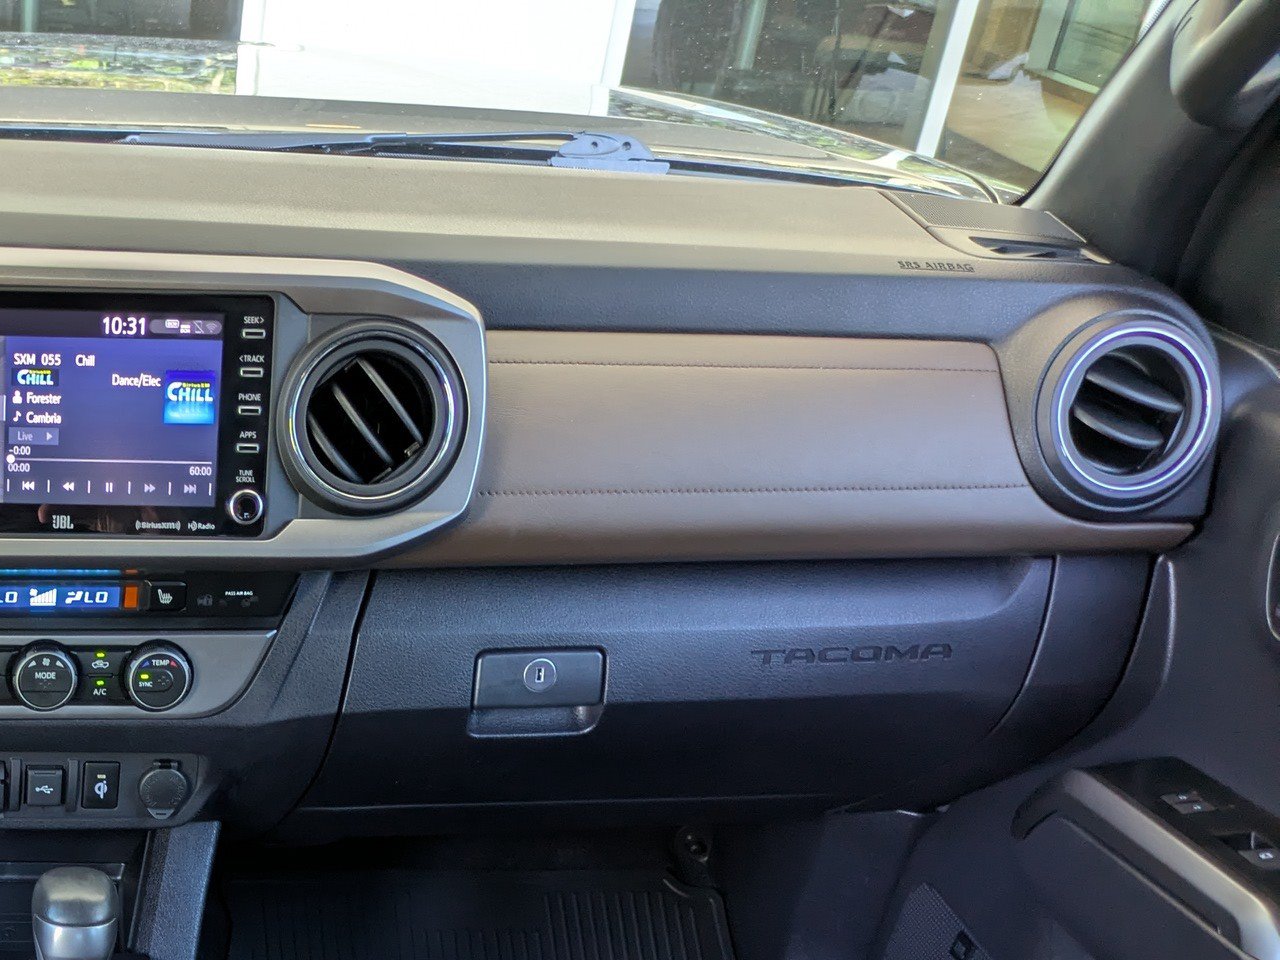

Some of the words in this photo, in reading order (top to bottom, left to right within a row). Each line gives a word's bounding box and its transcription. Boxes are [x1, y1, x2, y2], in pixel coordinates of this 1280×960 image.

[898, 260, 921, 270] SRS
[926, 261, 975, 272] AIRBAG
[102, 316, 146, 336] 10:31
[13, 353, 36, 366] SXM
[40, 353, 62, 366] 055
[75, 354, 96, 367] Chill
[16, 368, 54, 386] CHILL
[111, 372, 161, 388] Dance/Elec
[26, 391, 62, 405] Forester
[166, 382, 214, 402] CHILL
[238, 393, 262, 401] PHONE
[25, 411, 62, 424] Cambria
[17, 431, 33, 441] Live
[239, 431, 257, 439] APPS
[7, 463, 30, 473] 00:00
[189, 466, 212, 476] 60:00
[52, 515, 74, 529] JBL
[197, 522, 216, 530] Radio
[84, 590, 109, 604] LO
[750, 643, 953, 665] TACOMA
[151, 658, 170, 667] TEMP
[35, 671, 56, 680] MODE
[93, 687, 107, 696] A/C
